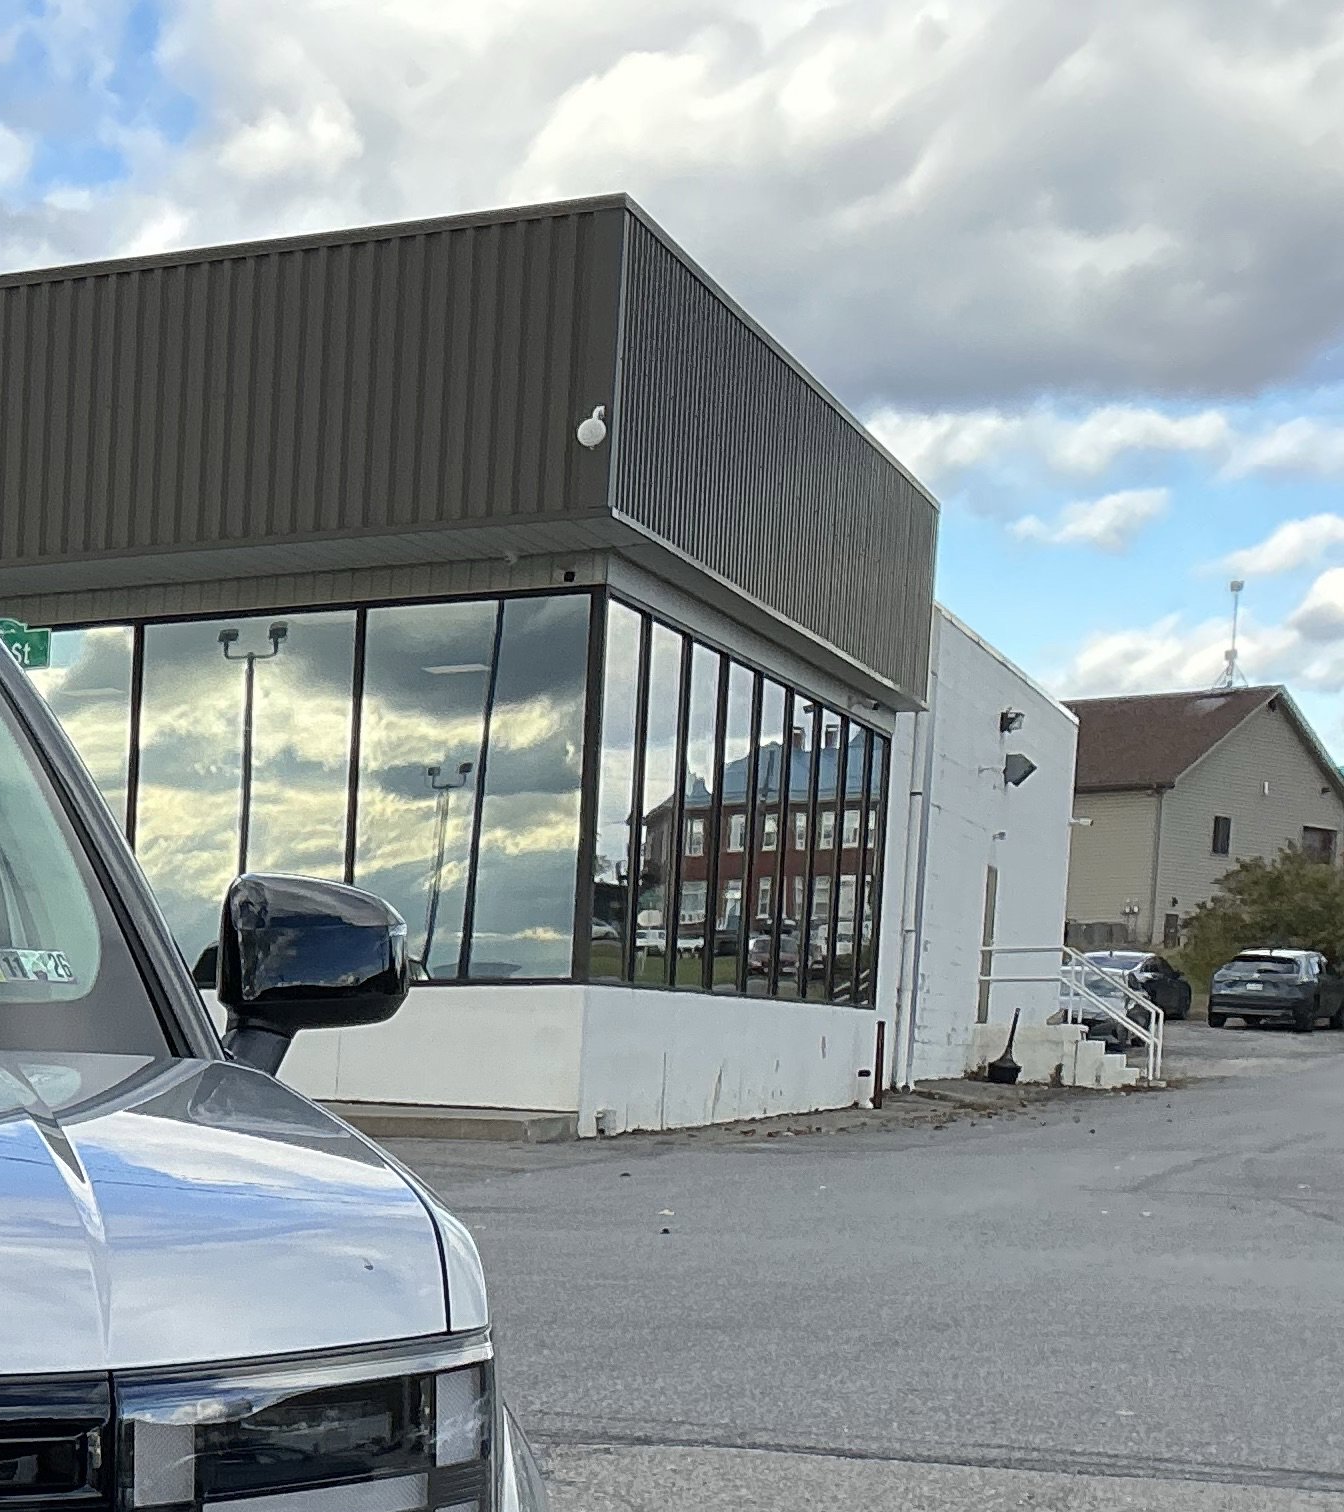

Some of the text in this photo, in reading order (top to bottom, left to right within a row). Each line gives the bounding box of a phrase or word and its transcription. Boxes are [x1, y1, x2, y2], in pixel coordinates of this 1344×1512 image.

[12, 642, 31, 665] St
[2, 953, 73, 980] 11 26
